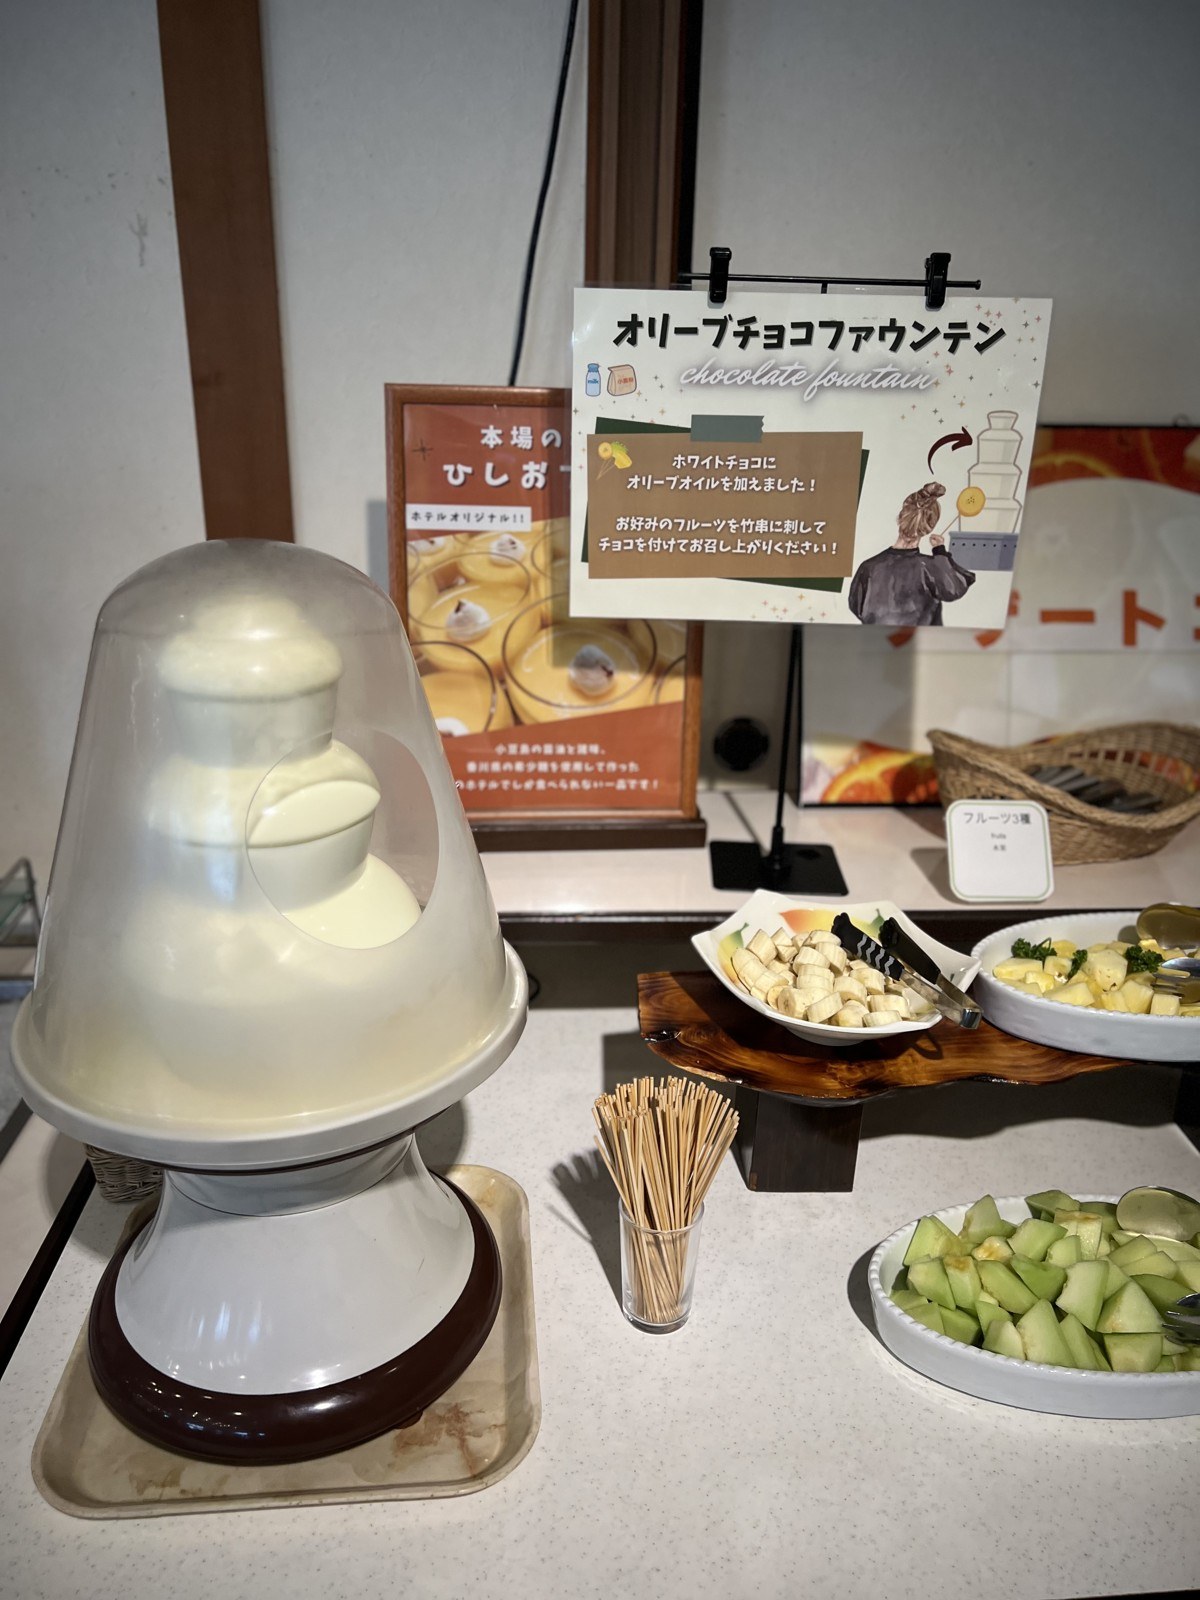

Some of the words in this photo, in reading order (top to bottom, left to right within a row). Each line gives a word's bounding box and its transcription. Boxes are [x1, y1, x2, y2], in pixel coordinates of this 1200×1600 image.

[613, 313, 1006, 355] オリーブチョコファウンテン
[679, 357, 805, 388] chocolate
[803, 359, 937, 401] fountain
[480, 425, 562, 449] 本場の
[672, 454, 776, 470] ホワイトチョコに
[627, 474, 816, 492] オリーブオイルを加えました！
[615, 516, 826, 535] お好みのフルーツを竹串に刺して
[598, 537, 837, 555] チョコを付けてお召し上がりください！
[964, 812, 1031, 825] フルーツ3種
